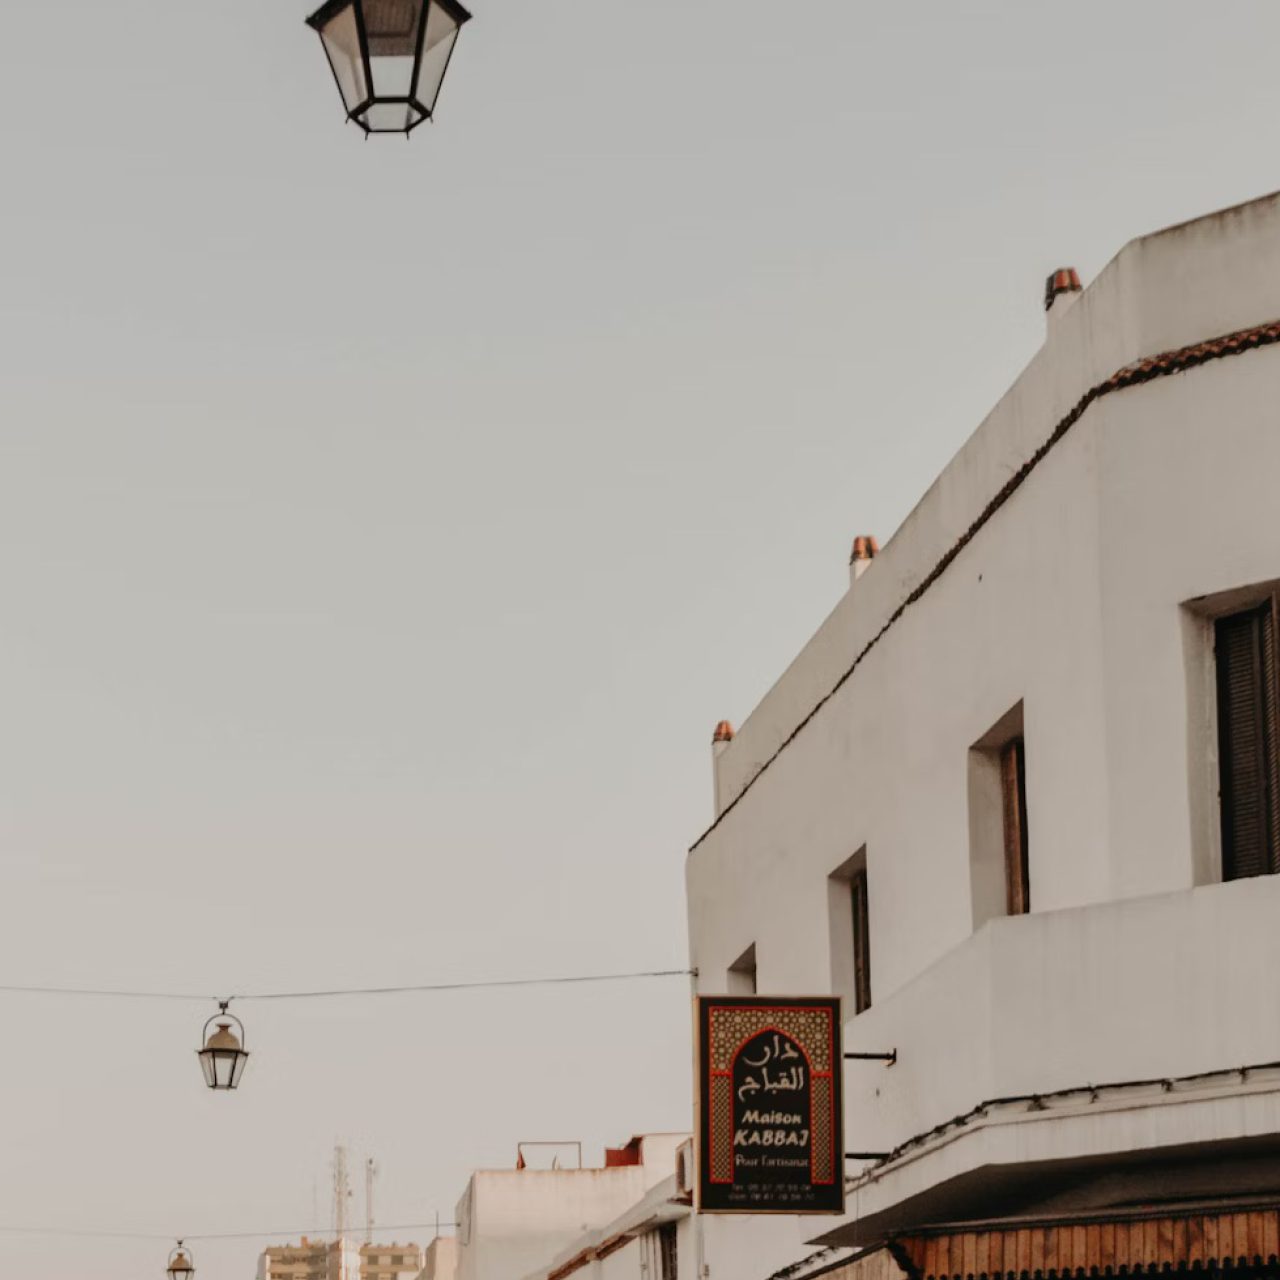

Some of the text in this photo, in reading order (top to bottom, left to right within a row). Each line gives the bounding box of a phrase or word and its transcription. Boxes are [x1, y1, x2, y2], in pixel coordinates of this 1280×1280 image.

[742, 1034, 799, 1066] دار
[738, 1066, 804, 1102] القباج
[741, 1110, 802, 1125] Maison
[733, 1129, 810, 1147] KABBAJ
